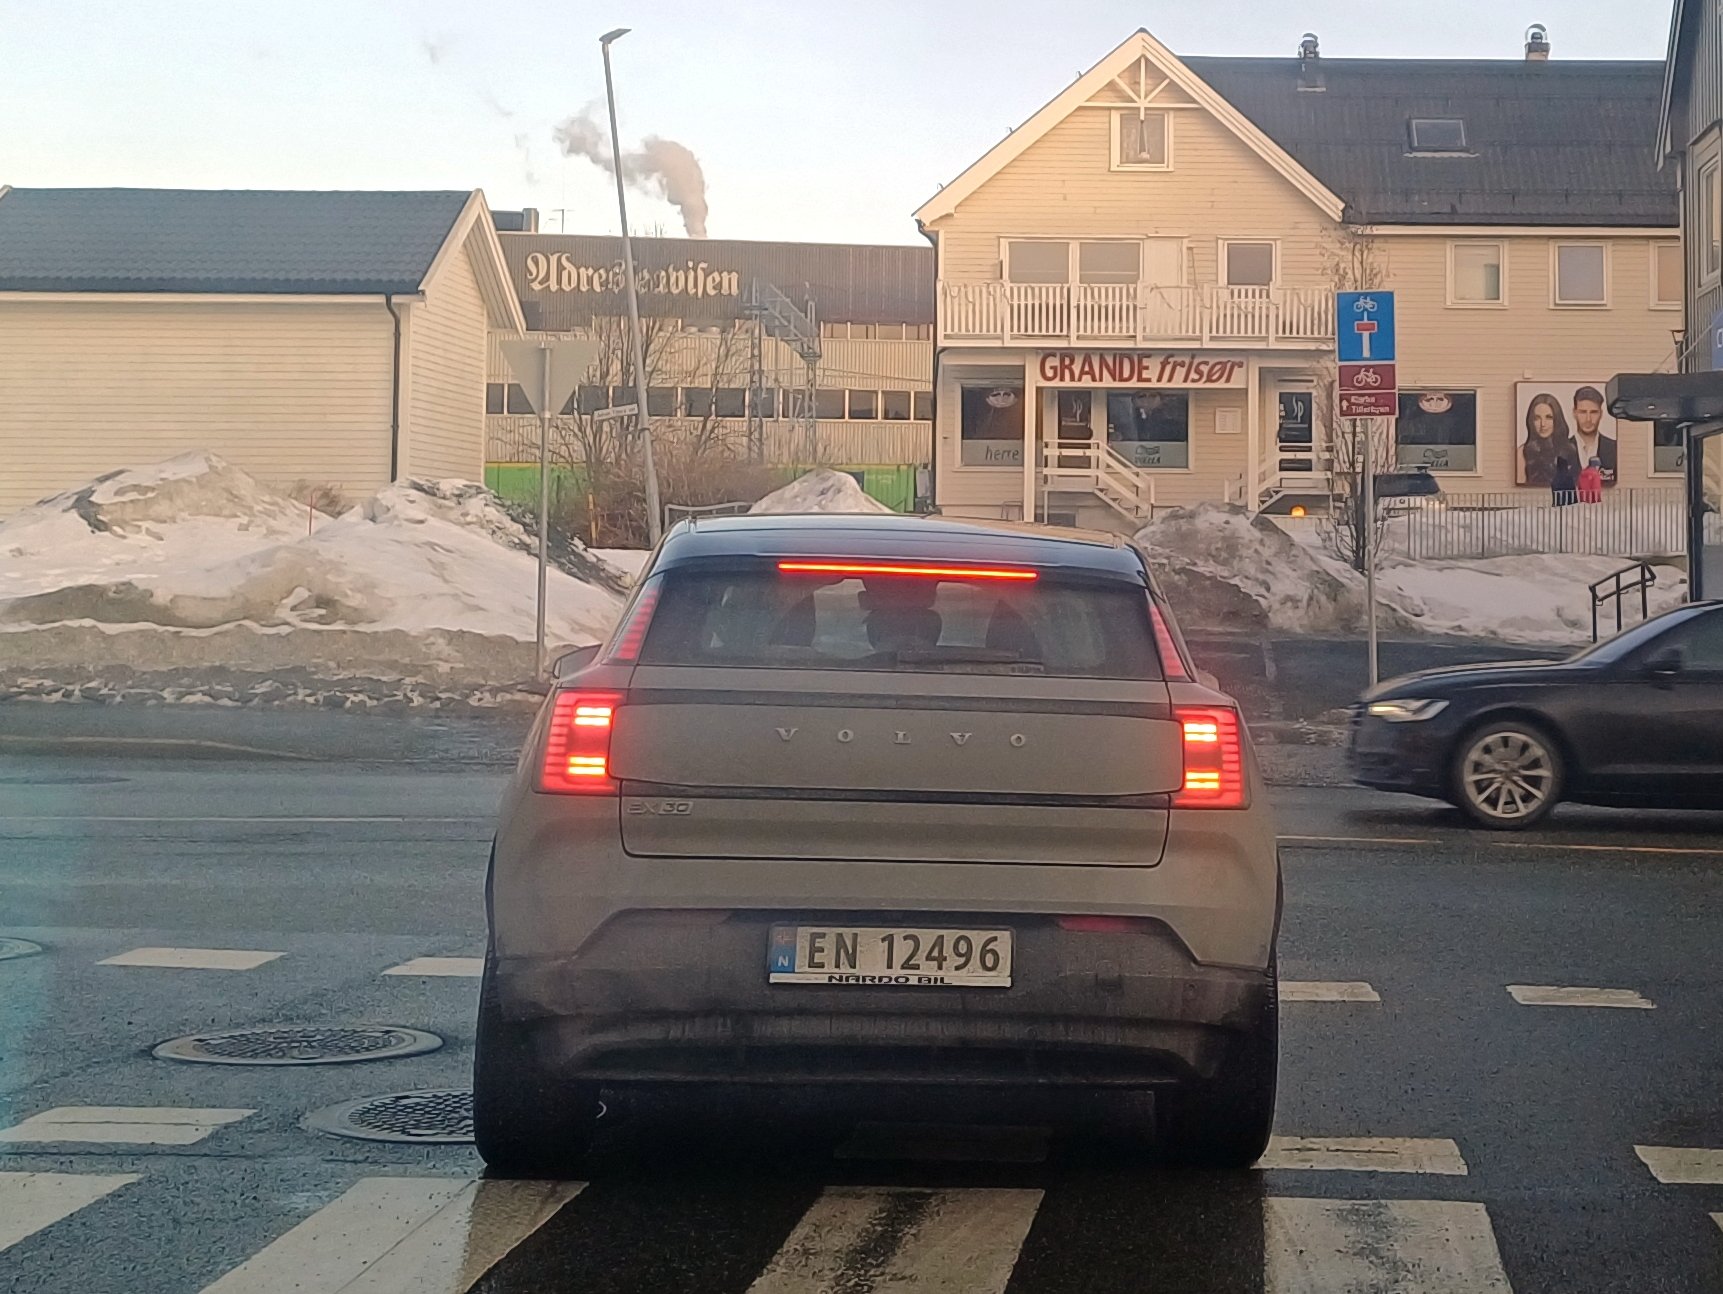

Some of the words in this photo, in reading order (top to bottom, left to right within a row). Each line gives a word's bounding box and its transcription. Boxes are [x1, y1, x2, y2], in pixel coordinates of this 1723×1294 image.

[1039, 352, 1152, 383] GRANDE
[1156, 353, 1244, 384] frisør
[985, 445, 1020, 460] herre
[775, 727, 1026, 747] VOLVO
[627, 801, 693, 815] EX30
[807, 932, 859, 970] EN
[880, 933, 1001, 972] 12496
[777, 955, 789, 967] N
[827, 974, 910, 985] NARDO
[917, 976, 953, 985] BIL
